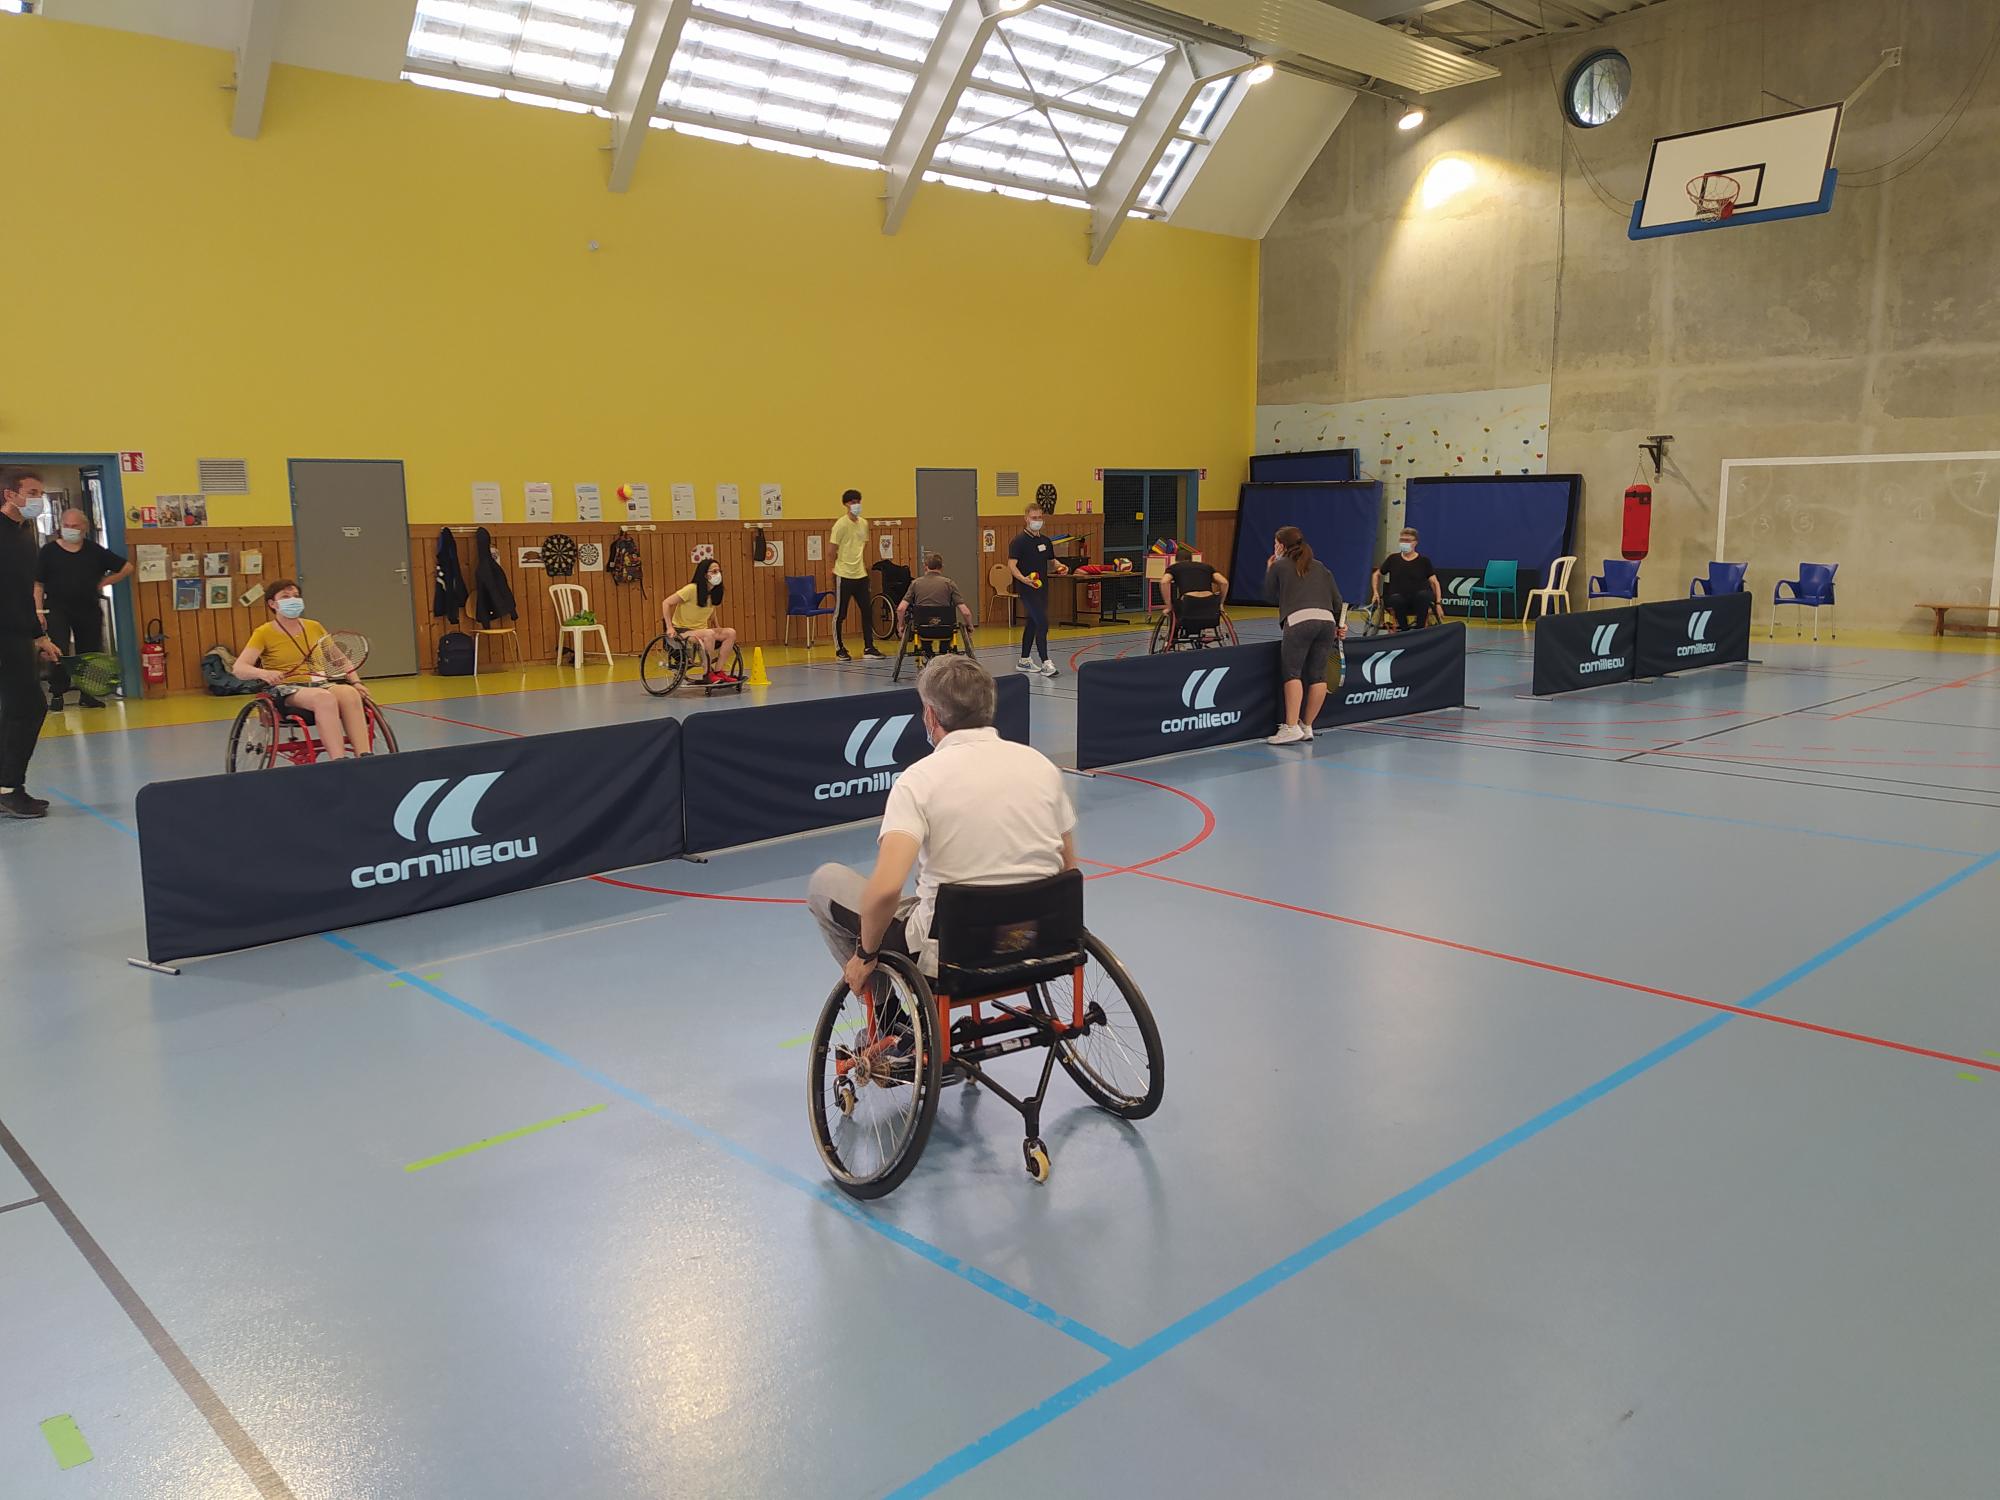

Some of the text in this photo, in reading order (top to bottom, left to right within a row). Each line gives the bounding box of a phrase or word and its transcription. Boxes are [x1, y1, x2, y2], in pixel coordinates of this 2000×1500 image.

[1440, 598, 1488, 607] ornilleau
[1677, 642, 1716, 656] cornilleau
[1579, 657, 1625, 673] cornilleau
[1345, 686, 1410, 705] cornilleau
[1161, 711, 1242, 734] cornilleau
[351, 836, 538, 888] cornilleau
